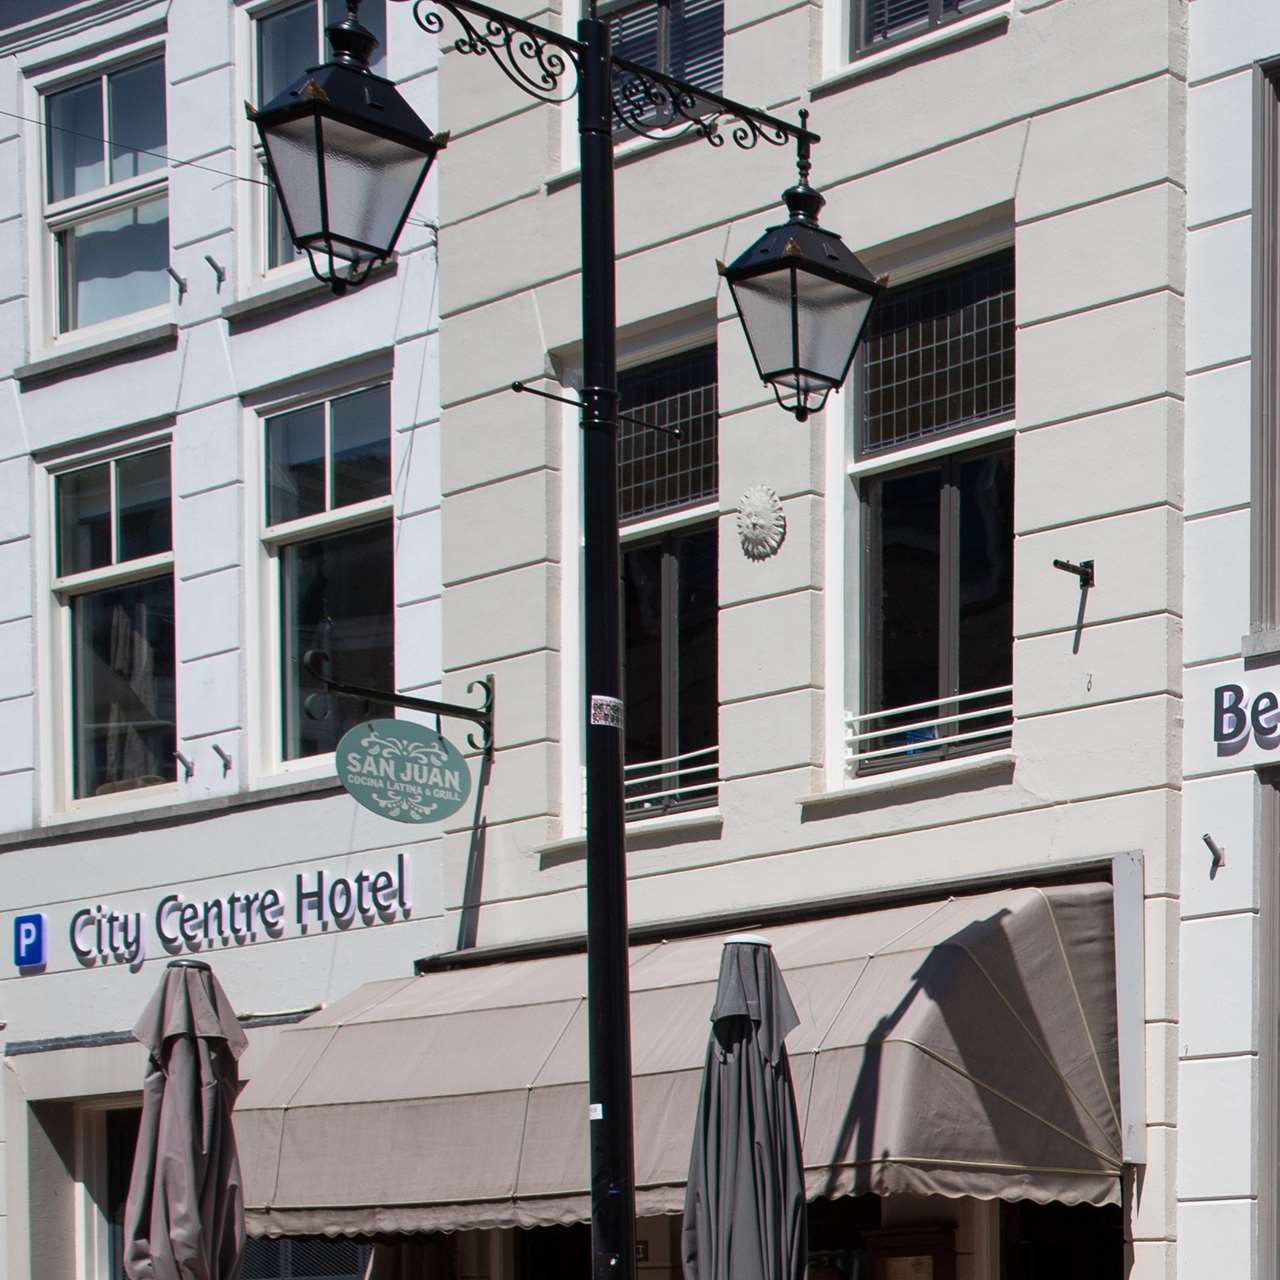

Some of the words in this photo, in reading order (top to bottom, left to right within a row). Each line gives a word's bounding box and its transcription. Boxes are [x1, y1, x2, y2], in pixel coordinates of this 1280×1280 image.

[346, 752, 397, 781] SAN
[400, 761, 462, 793] JUAN
[347, 774, 385, 789] COCINA
[386, 780, 423, 796] LATINA
[432, 788, 462, 802] GRILL
[70, 905, 143, 962] City
[155, 888, 280, 945] Centre
[296, 854, 406, 924] Hotel
